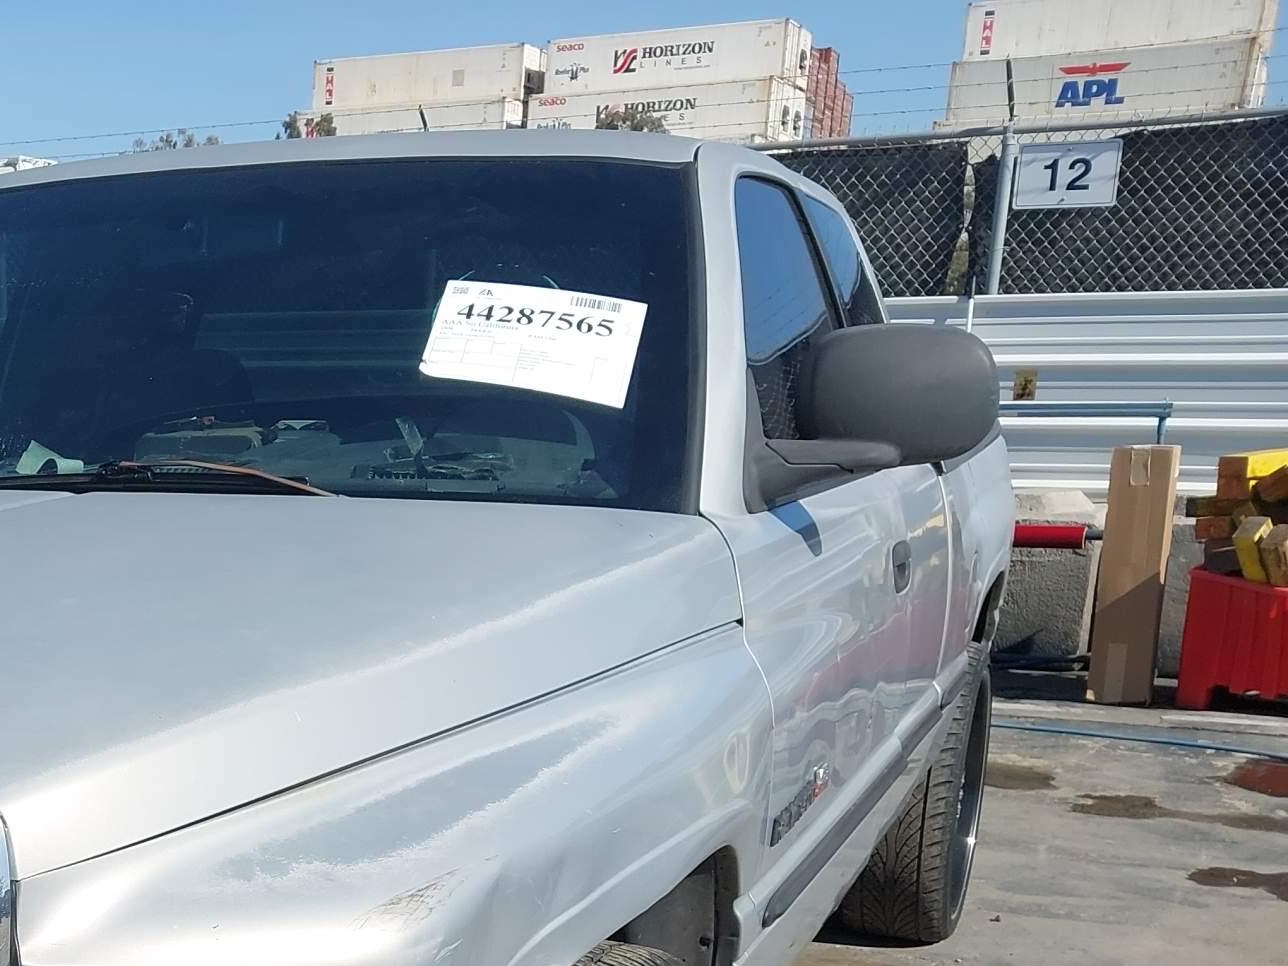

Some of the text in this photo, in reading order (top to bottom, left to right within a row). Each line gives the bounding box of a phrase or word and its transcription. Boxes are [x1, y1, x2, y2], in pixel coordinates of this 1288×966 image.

[556, 43, 585, 52] seaco
[641, 41, 715, 59] HORIZON
[640, 56, 702, 68] LINES
[1055, 78, 1125, 107] APL
[538, 97, 567, 106] seaco
[624, 98, 697, 114] HORIZON
[1043, 157, 1092, 191] 12
[456, 303, 616, 337] 44287565
